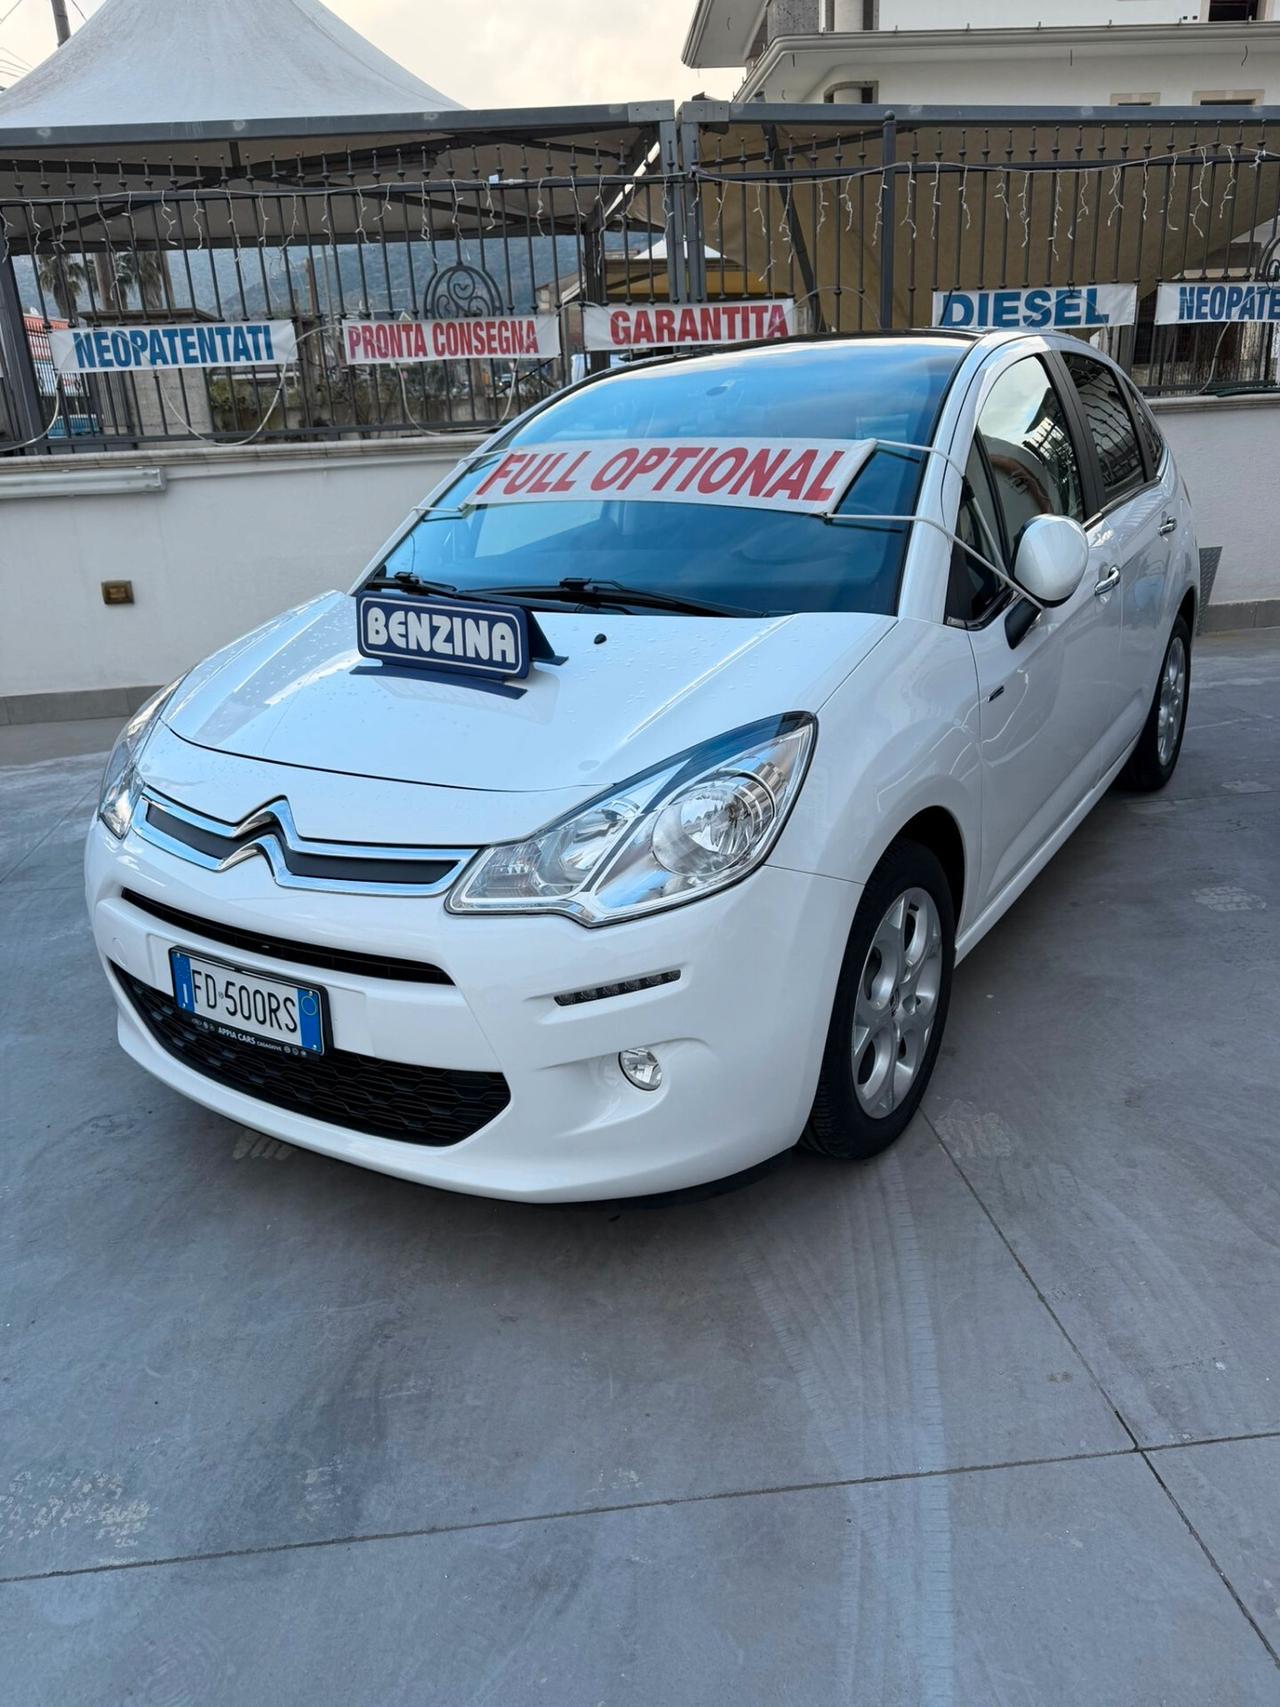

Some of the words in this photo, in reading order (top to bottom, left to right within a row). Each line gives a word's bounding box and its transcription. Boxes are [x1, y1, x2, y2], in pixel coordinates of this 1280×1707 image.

[609, 304, 789, 346] GARANTITA
[941, 287, 1110, 328] DIESEL
[72, 324, 275, 369] NEOPATENTATI
[347, 322, 428, 360] PRONTA
[432, 319, 540, 356] CONSEGNA
[475, 450, 592, 496] FULL
[590, 447, 846, 502] OPTIONAL
[366, 605, 517, 664] BENZINA
[217, 1026, 237, 1040] APPIA
[237, 1033, 257, 1046] CARS
